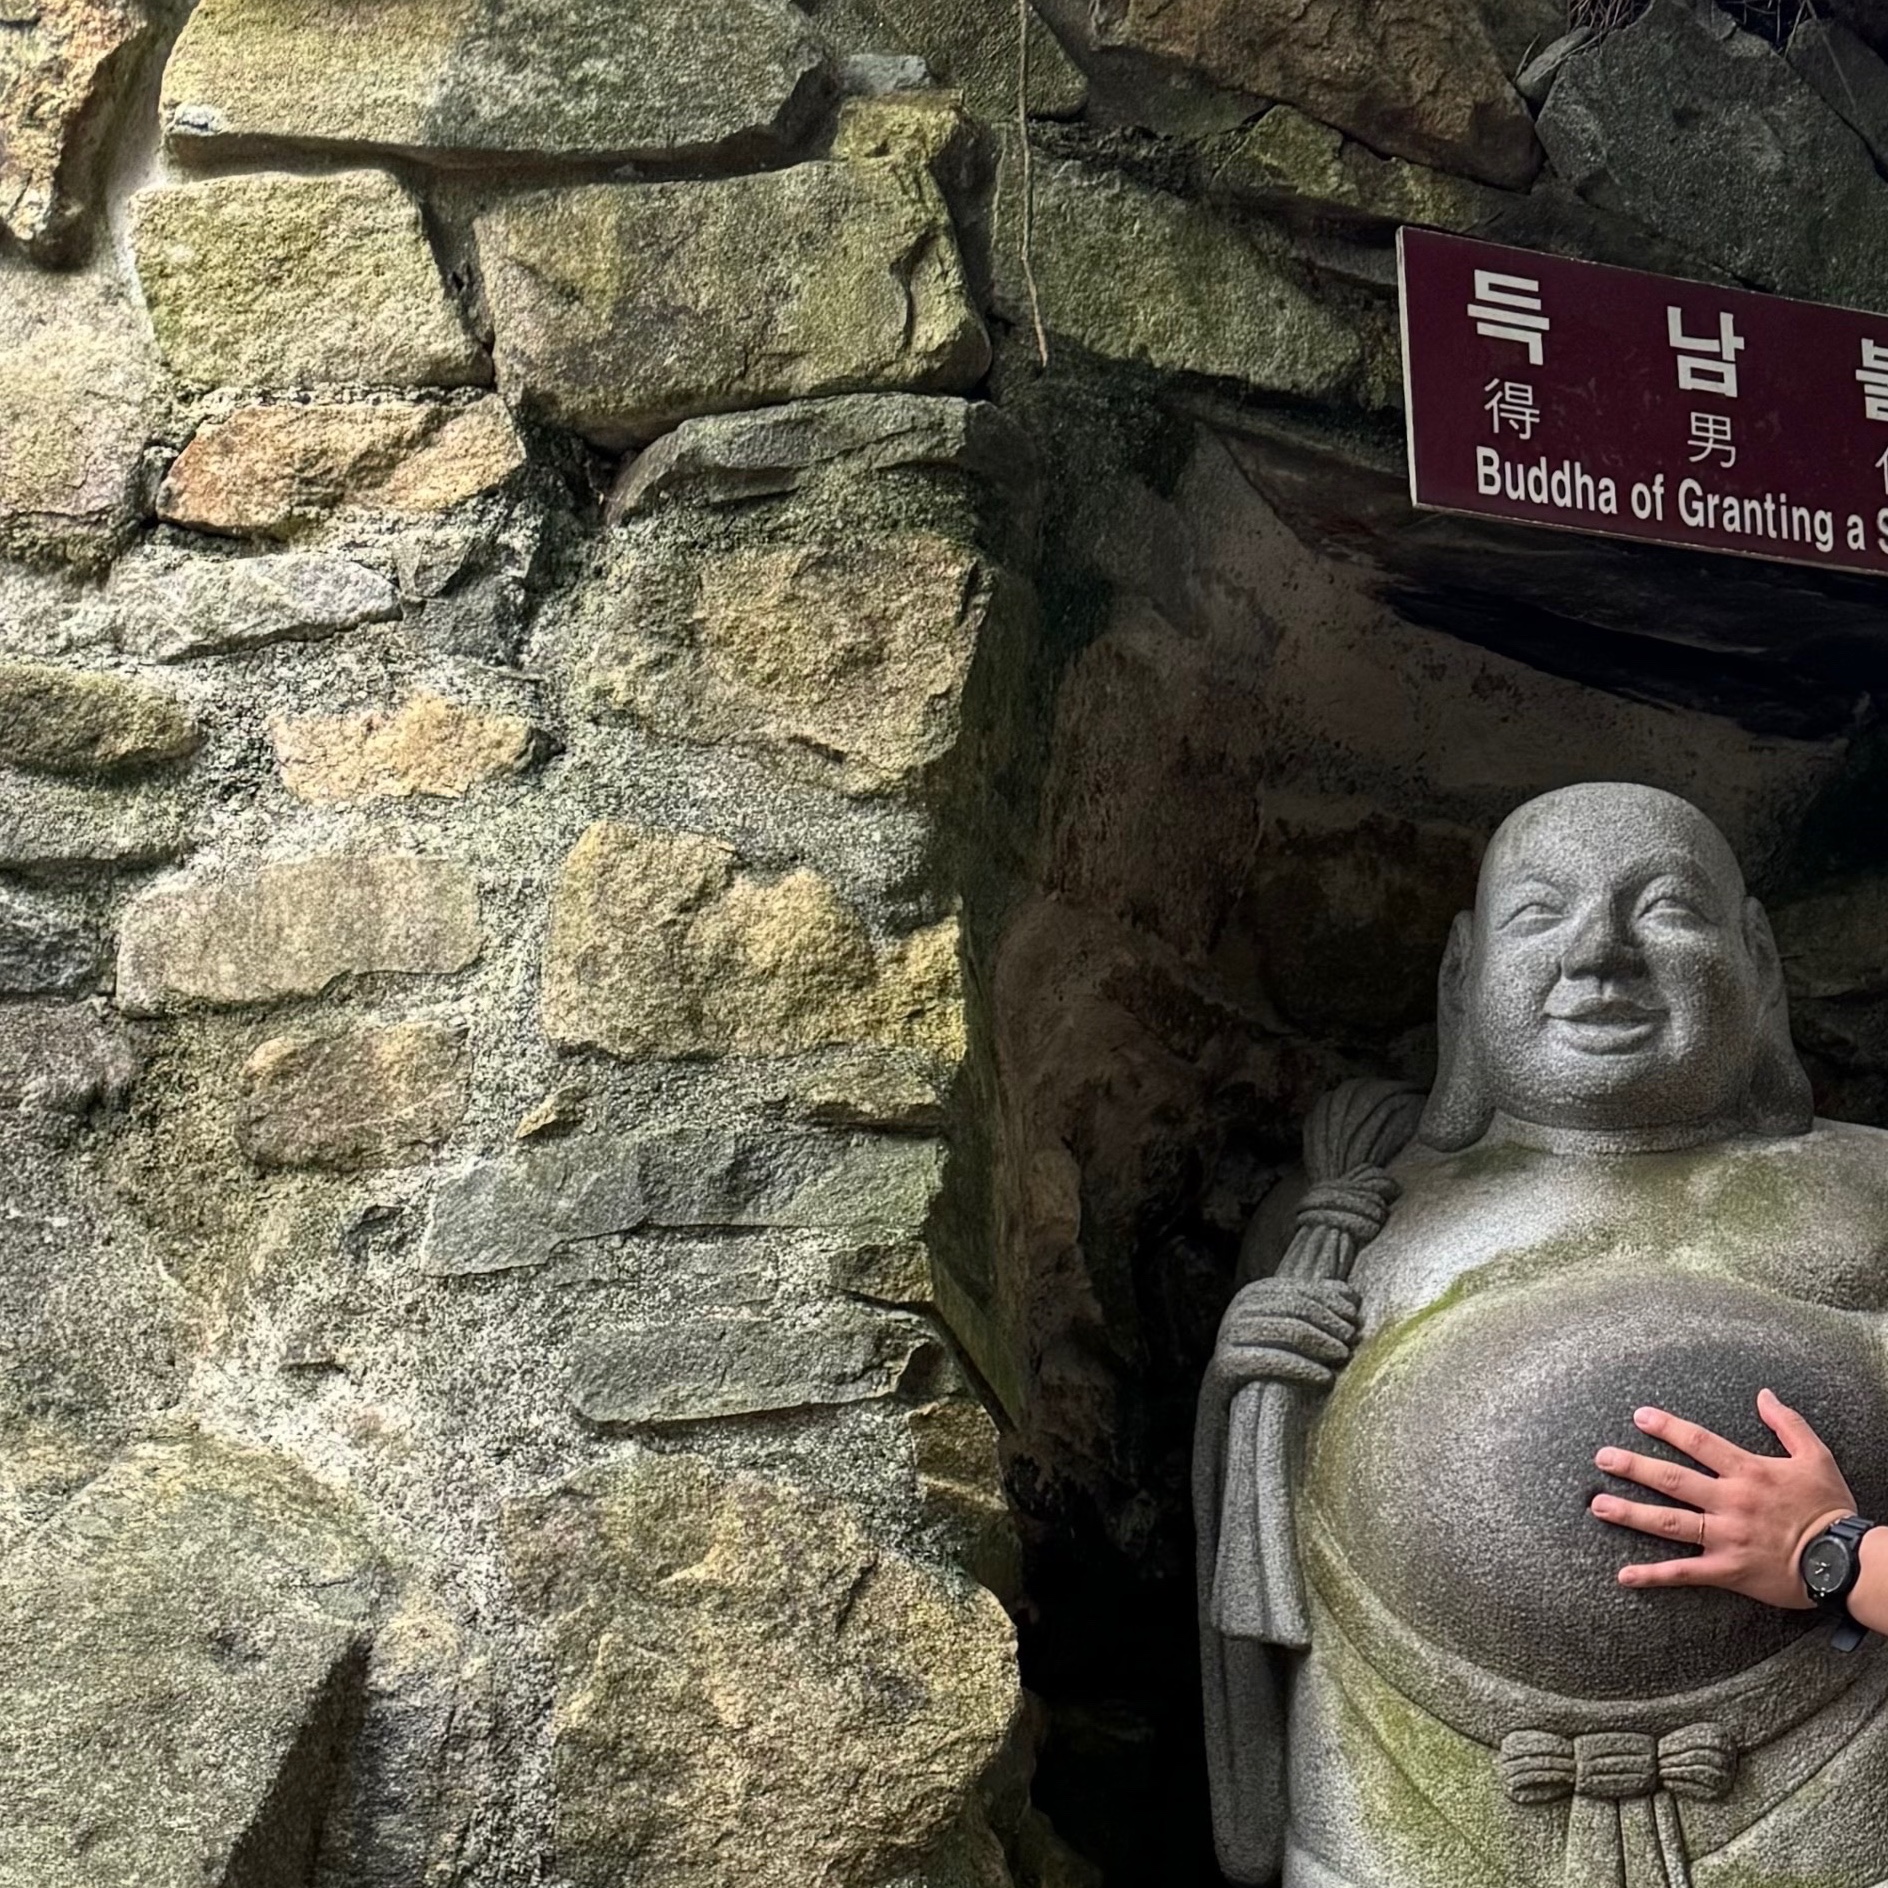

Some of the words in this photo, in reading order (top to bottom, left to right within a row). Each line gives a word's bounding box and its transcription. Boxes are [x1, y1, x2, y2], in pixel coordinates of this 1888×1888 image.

[1475, 446, 1617, 514] Buddha
[1631, 473, 1665, 521] of
[1678, 478, 1834, 552] Granting
[1846, 514, 1866, 551] a
